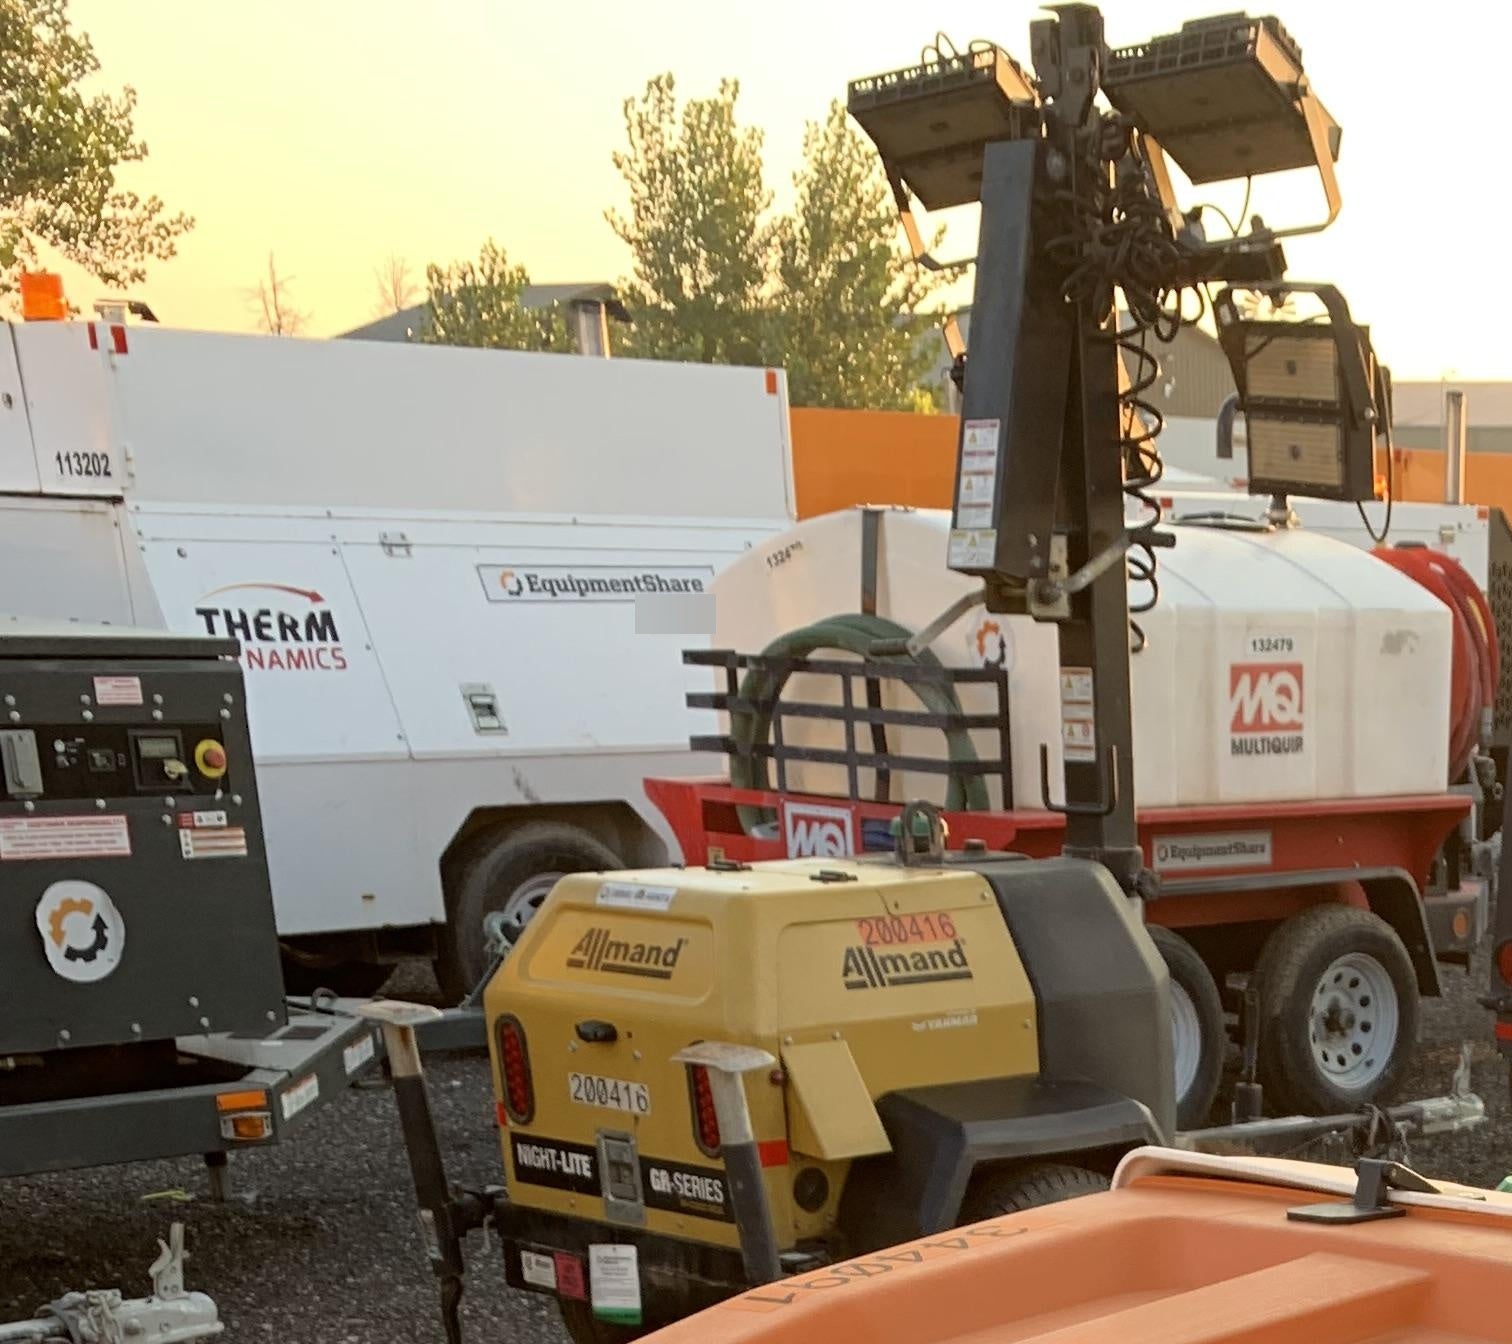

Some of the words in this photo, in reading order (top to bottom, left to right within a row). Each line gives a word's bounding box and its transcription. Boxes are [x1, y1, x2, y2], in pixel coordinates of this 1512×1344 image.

[55, 451, 111, 478] 113202
[525, 574, 705, 597] EquipmentShare
[195, 608, 340, 642] THERM
[1252, 638, 1293, 652] 132479
[1230, 669, 1303, 726] MQ
[858, 912, 958, 945] 200416
[568, 928, 683, 972] Allmand
[842, 939, 972, 988] Allmand
[570, 1073, 649, 1112] 200416
[516, 1142, 593, 1178] NIGHT-LITE
